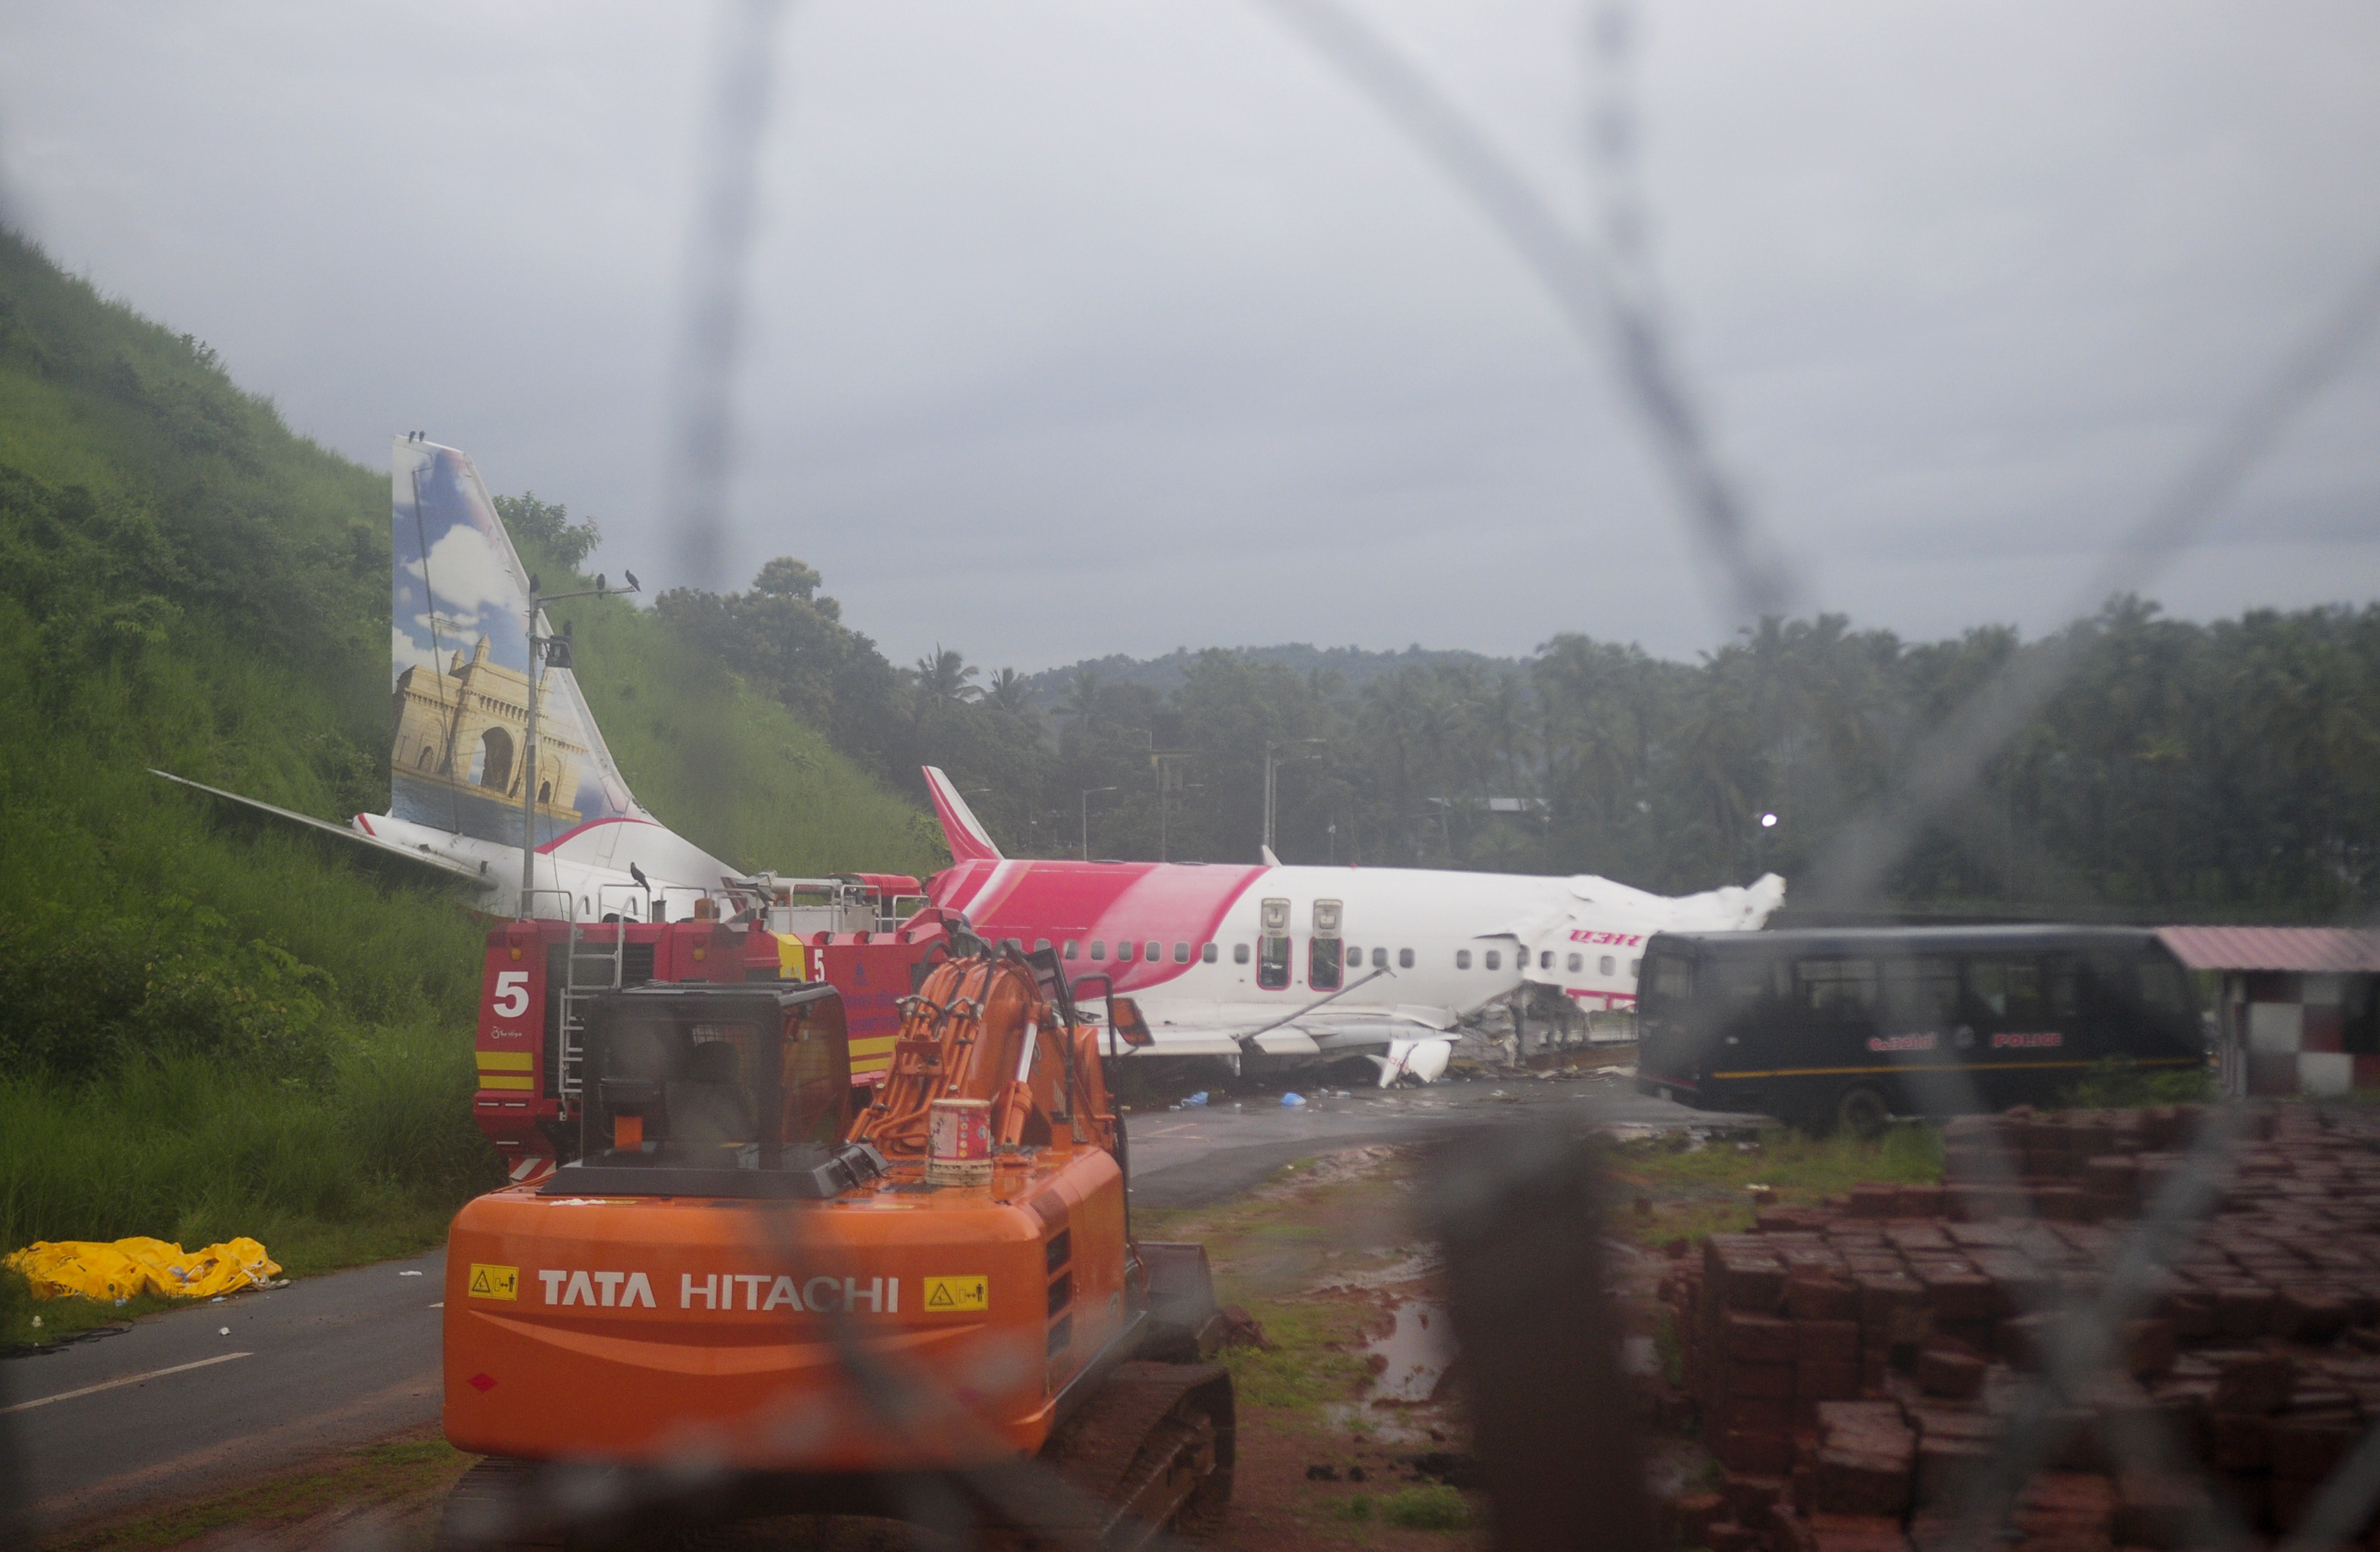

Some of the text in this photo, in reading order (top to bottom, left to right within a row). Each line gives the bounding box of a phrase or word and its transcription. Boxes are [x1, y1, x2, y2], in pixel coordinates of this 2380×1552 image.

[814, 949, 826, 984] 5
[493, 971, 529, 1018] 5
[1992, 1032, 2062, 1048] POLICE
[539, 1269, 899, 1313] TATA HITACHI
